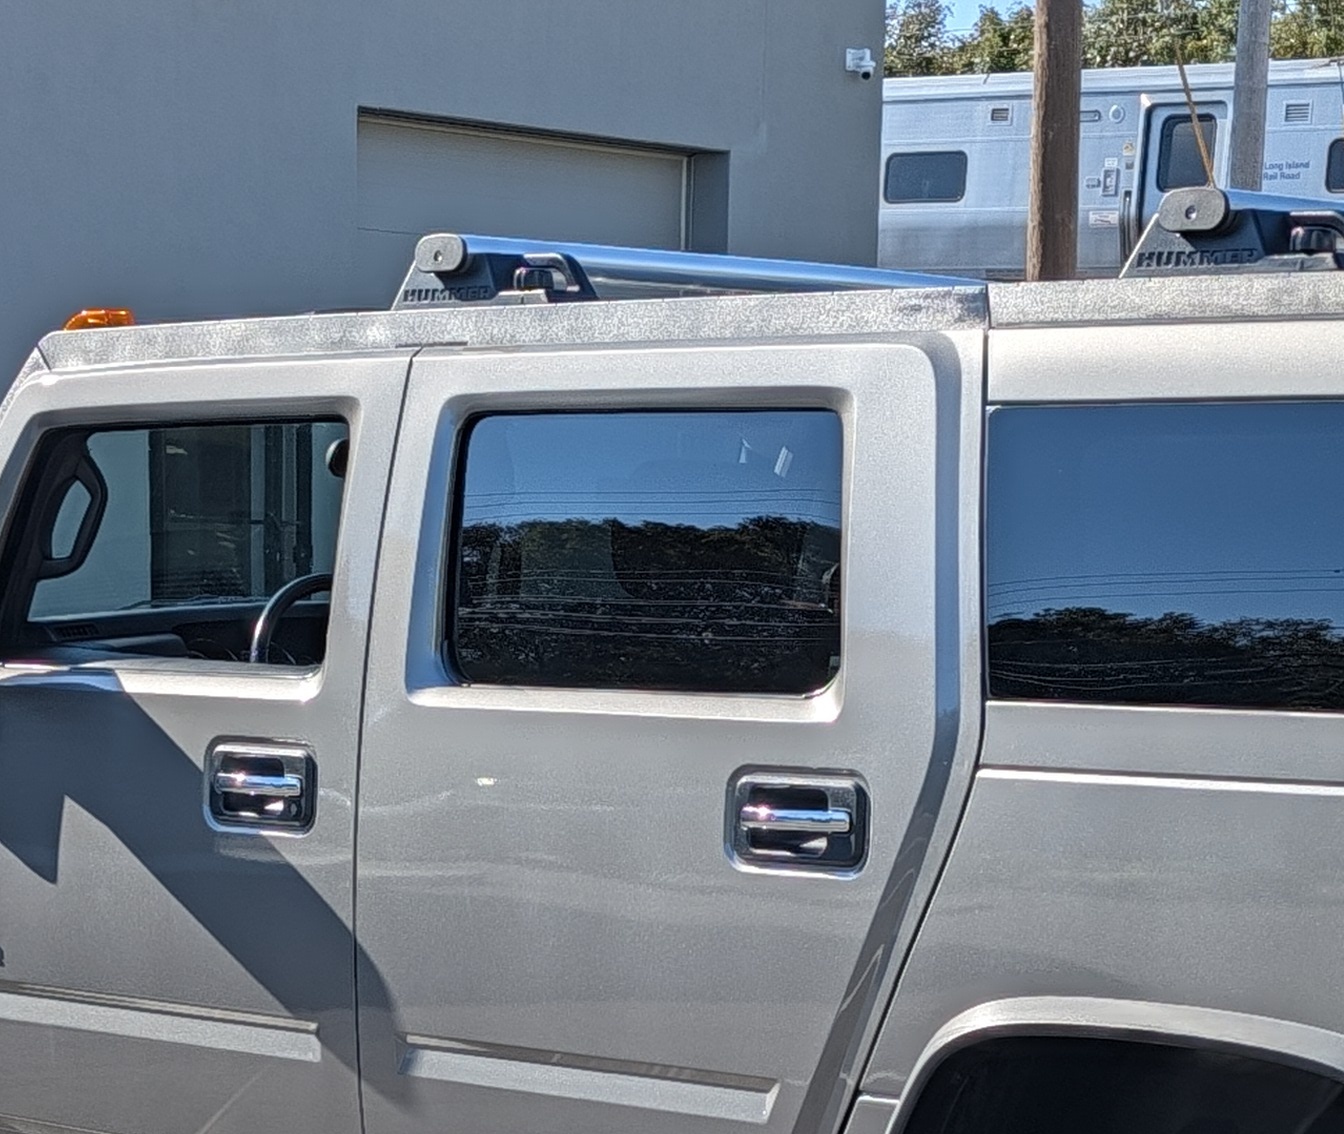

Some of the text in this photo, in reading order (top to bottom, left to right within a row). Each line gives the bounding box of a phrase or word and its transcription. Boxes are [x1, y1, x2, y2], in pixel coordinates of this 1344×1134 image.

[1264, 162, 1284, 171] Long
[1279, 171, 1301, 180] Road
[1135, 247, 1260, 269] HUMMER
[402, 285, 492, 302] HUMMER
